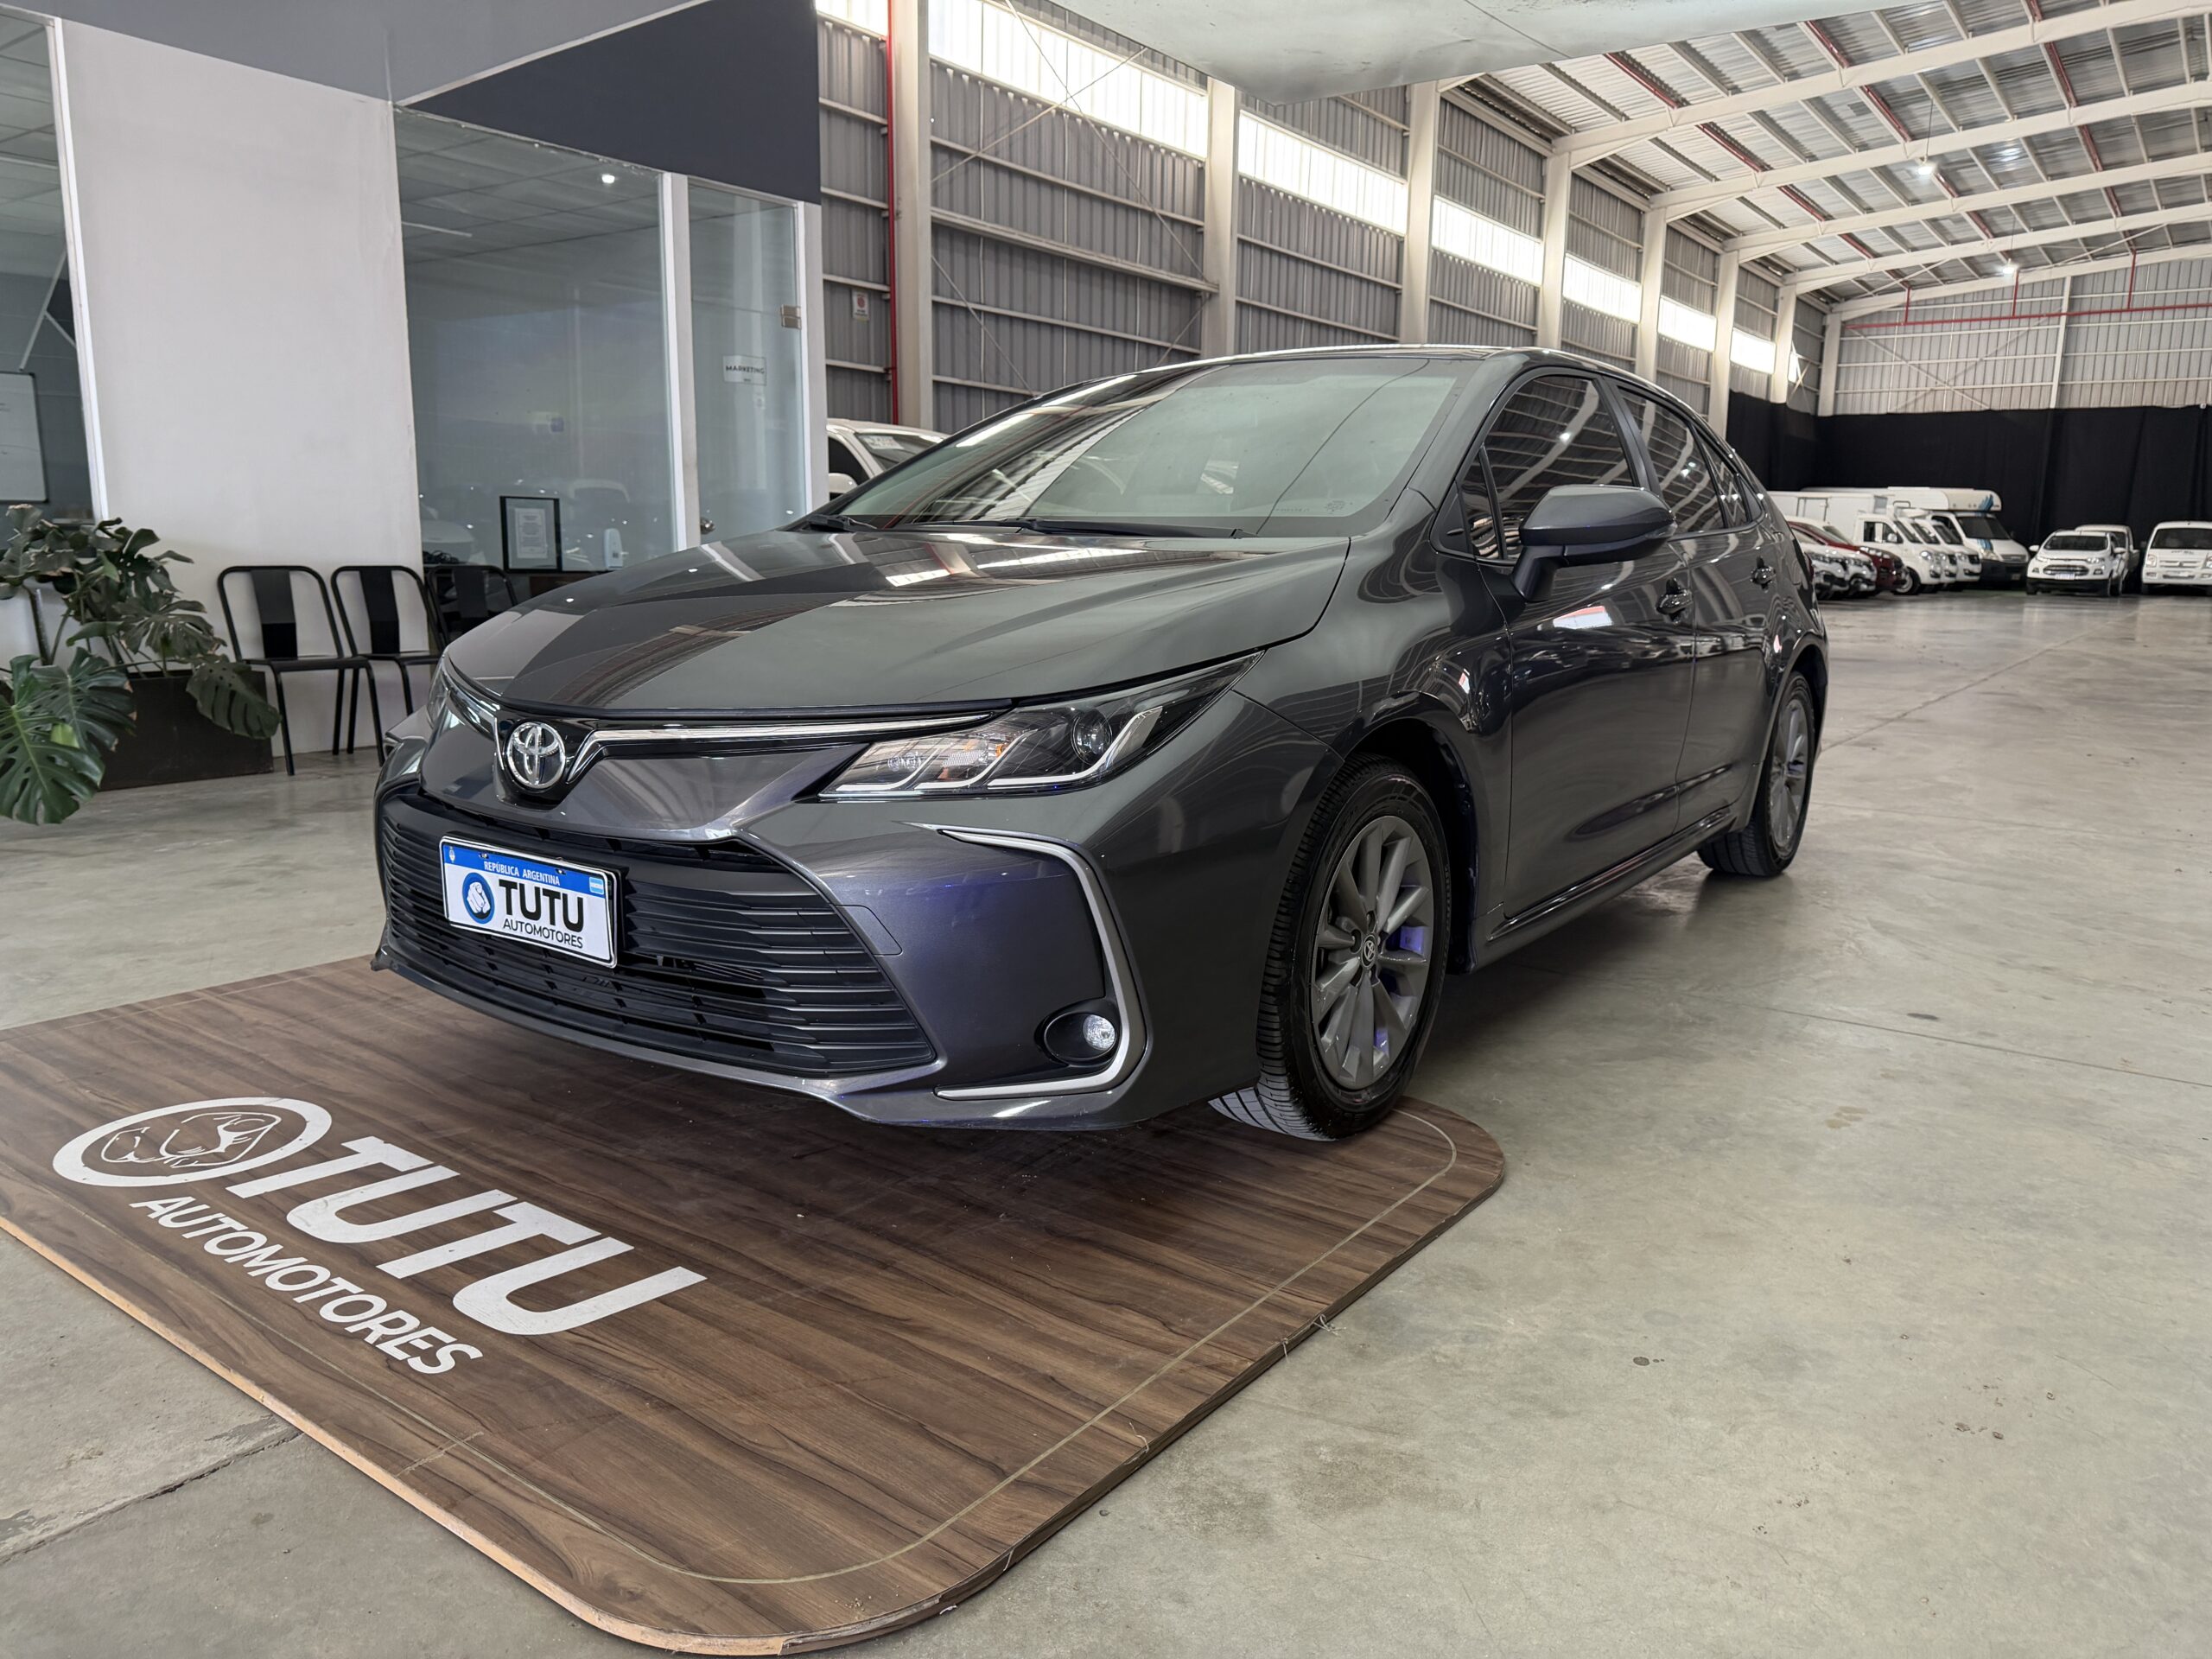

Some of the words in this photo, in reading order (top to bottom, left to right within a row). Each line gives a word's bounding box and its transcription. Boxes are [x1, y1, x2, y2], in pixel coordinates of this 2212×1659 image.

[726, 365, 765, 374] MARKETING
[483, 861, 520, 878] REPÚBLICA
[522, 868, 560, 887] ARGENTINA
[499, 879, 584, 933] TUTU
[502, 918, 583, 949] AUTOMOTORES
[226, 1136, 707, 1335] TUTU
[129, 1197, 482, 1374] AUTOMOTORES
